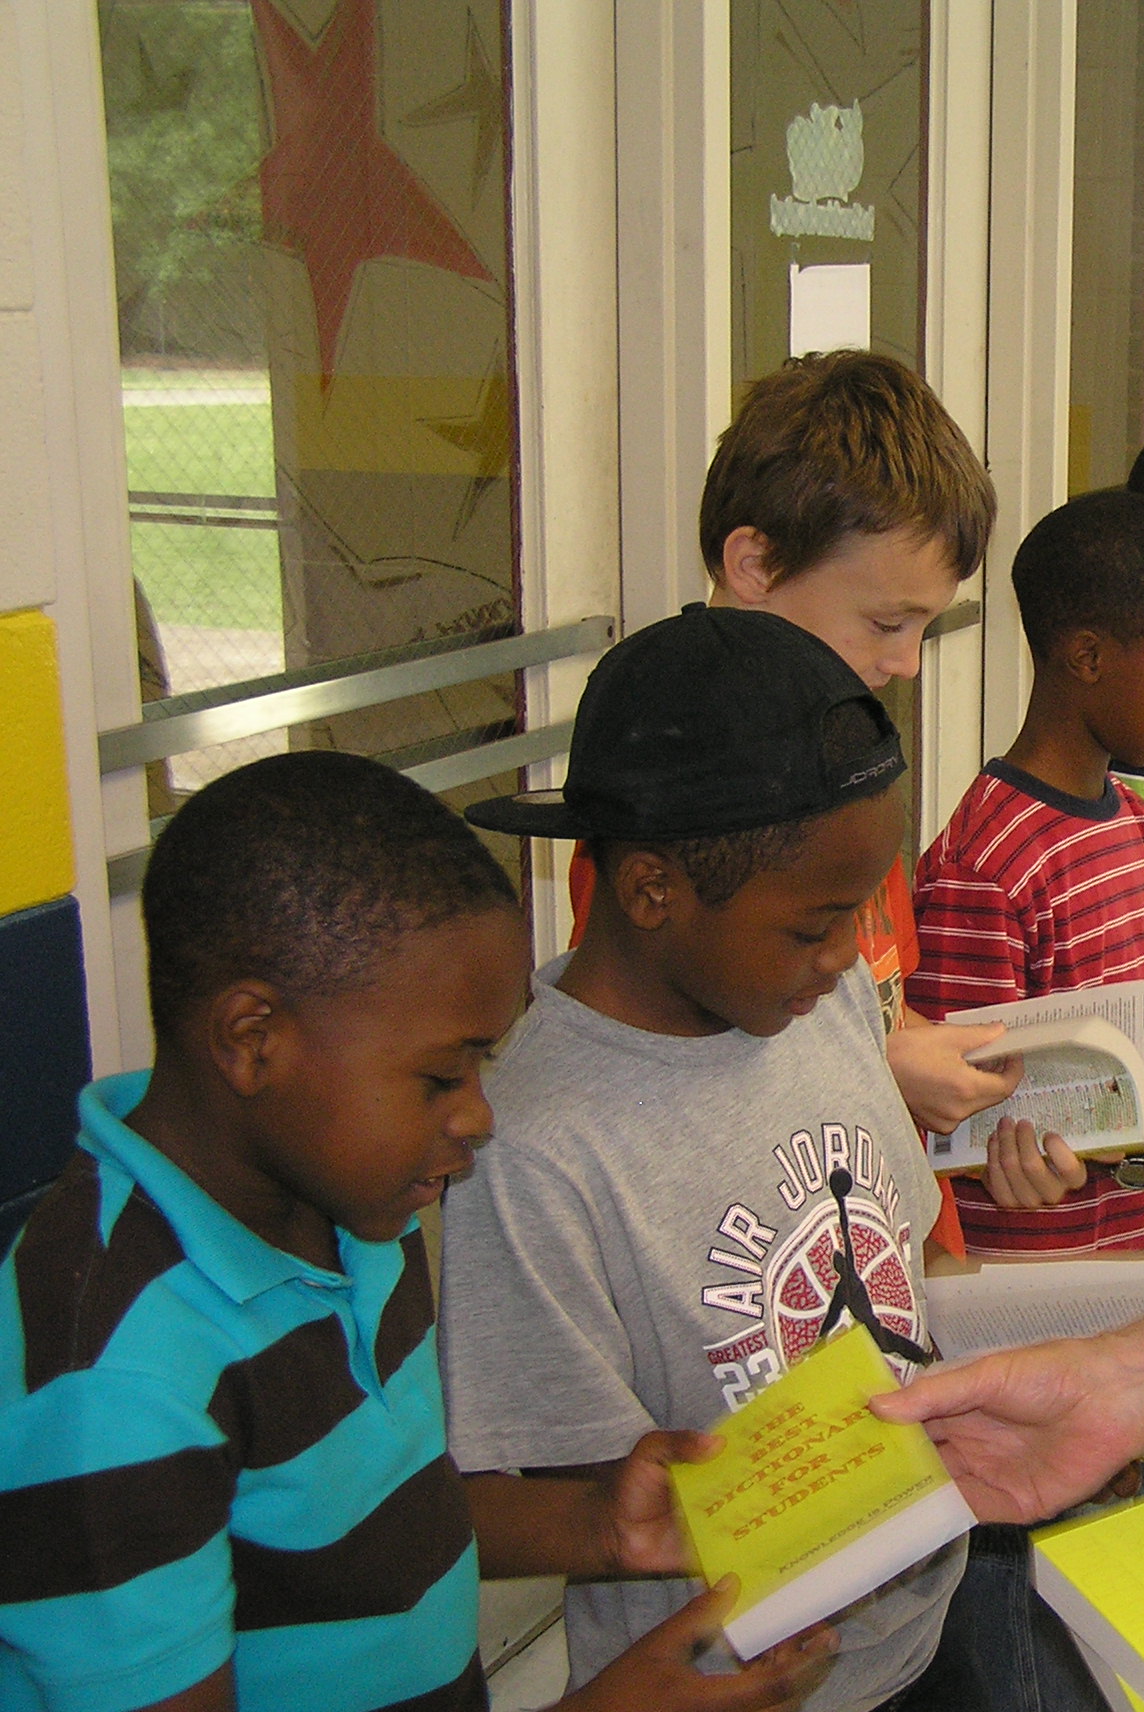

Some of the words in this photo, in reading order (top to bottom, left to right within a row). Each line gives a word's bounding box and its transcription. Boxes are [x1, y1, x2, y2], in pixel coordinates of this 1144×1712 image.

[701, 1202, 779, 1319] AIR
[707, 1330, 769, 1365] GREATEST
[712, 1347, 784, 1414] 23
[749, 1401, 806, 1444] THE
[750, 1413, 818, 1465] BEST
[703, 1403, 872, 1518] DICTIONAR
[768, 1453, 832, 1497] FOR
[732, 1442, 886, 1541] STUDENTS
